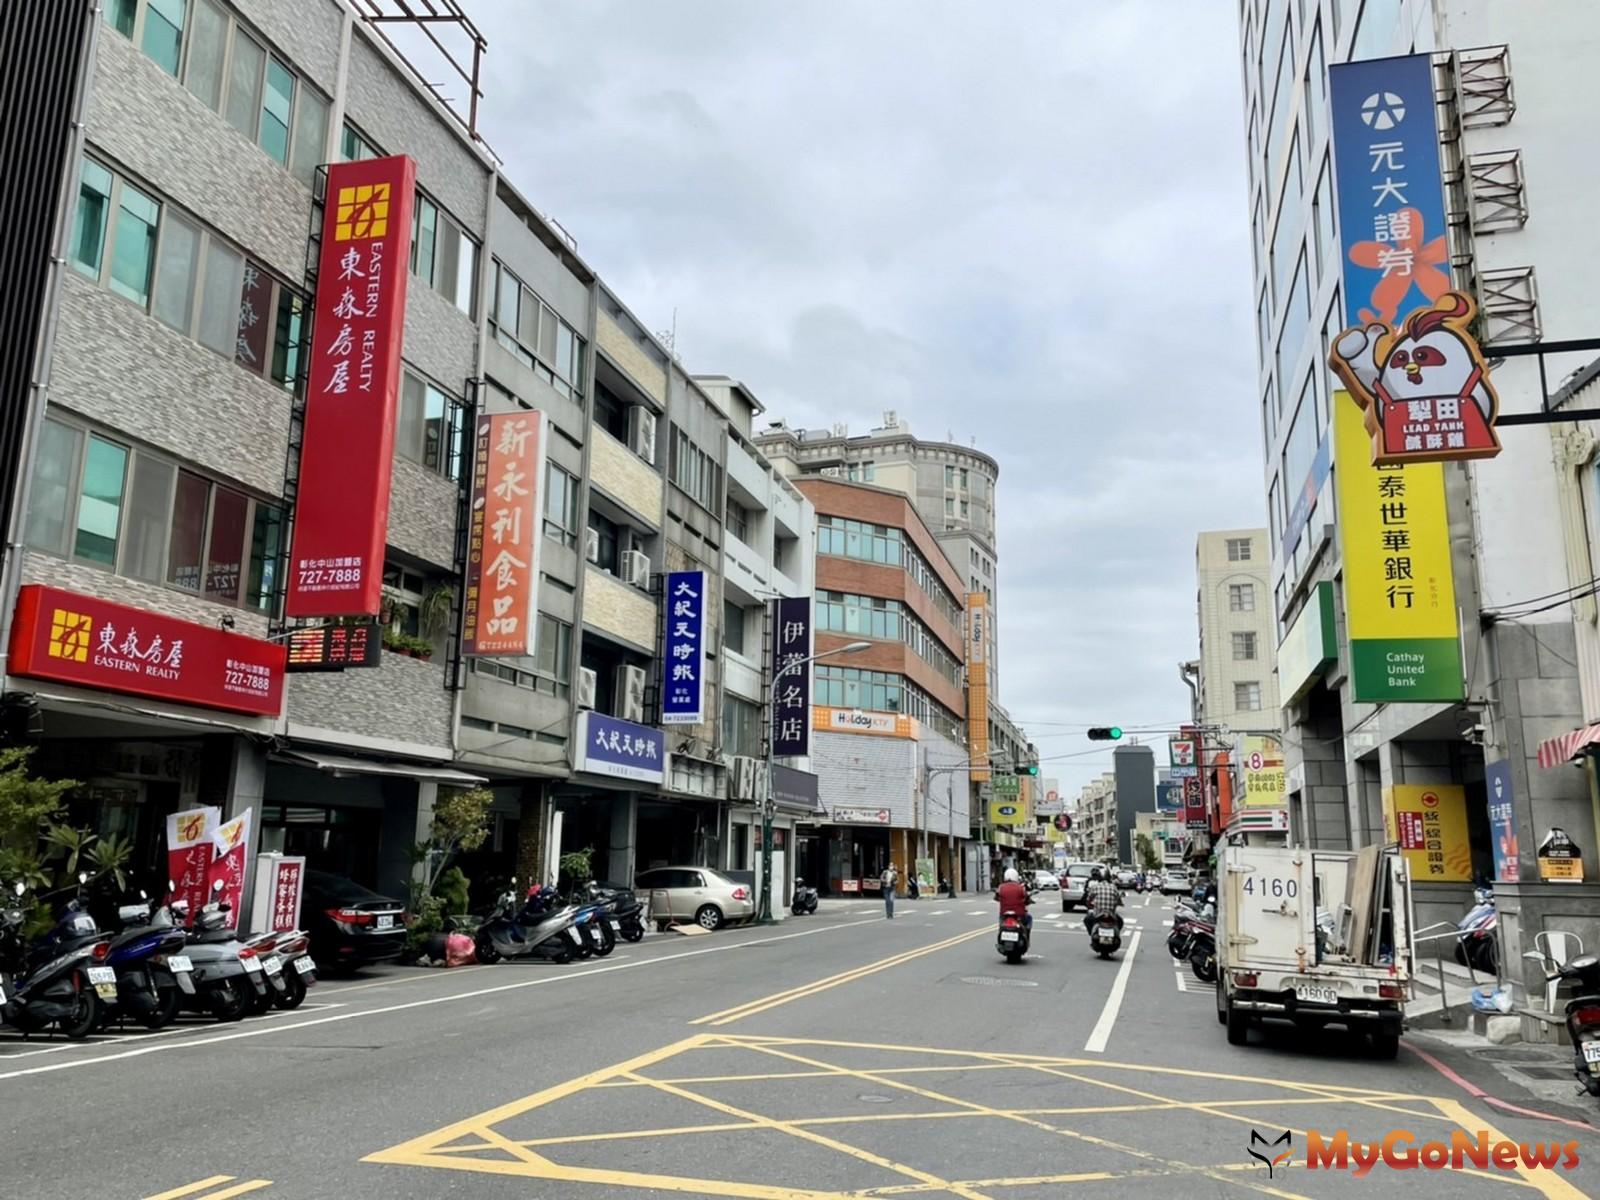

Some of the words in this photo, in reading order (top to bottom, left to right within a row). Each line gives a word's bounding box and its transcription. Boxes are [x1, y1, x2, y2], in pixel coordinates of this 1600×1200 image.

[1368, 141, 1414, 278] 元大證券
[365, 242, 383, 317] EASTERN
[322, 247, 365, 394] 東森房屋
[358, 330, 375, 392] REALTY
[1407, 399, 1459, 422] 犁田
[1402, 423, 1430, 433] LEAD
[1434, 421, 1464, 432] TANK
[486, 419, 534, 636] 新永利食品
[1376, 461, 1415, 609] 泰世華銀行
[299, 569, 361, 584] 727-7888
[97, 622, 184, 669] 東森房屋
[94, 656, 141, 673] EASTERN
[145, 665, 181, 681] REALTY
[1386, 652, 1425, 664] Cathay
[1387, 664, 1425, 674] United
[225, 670, 270, 690] 727-7888
[1388, 676, 1416, 687] Bank
[1251, 753, 1261, 769] 8
[1424, 811, 1444, 874] 統一綜合證券
[1243, 877, 1298, 898] 4160
